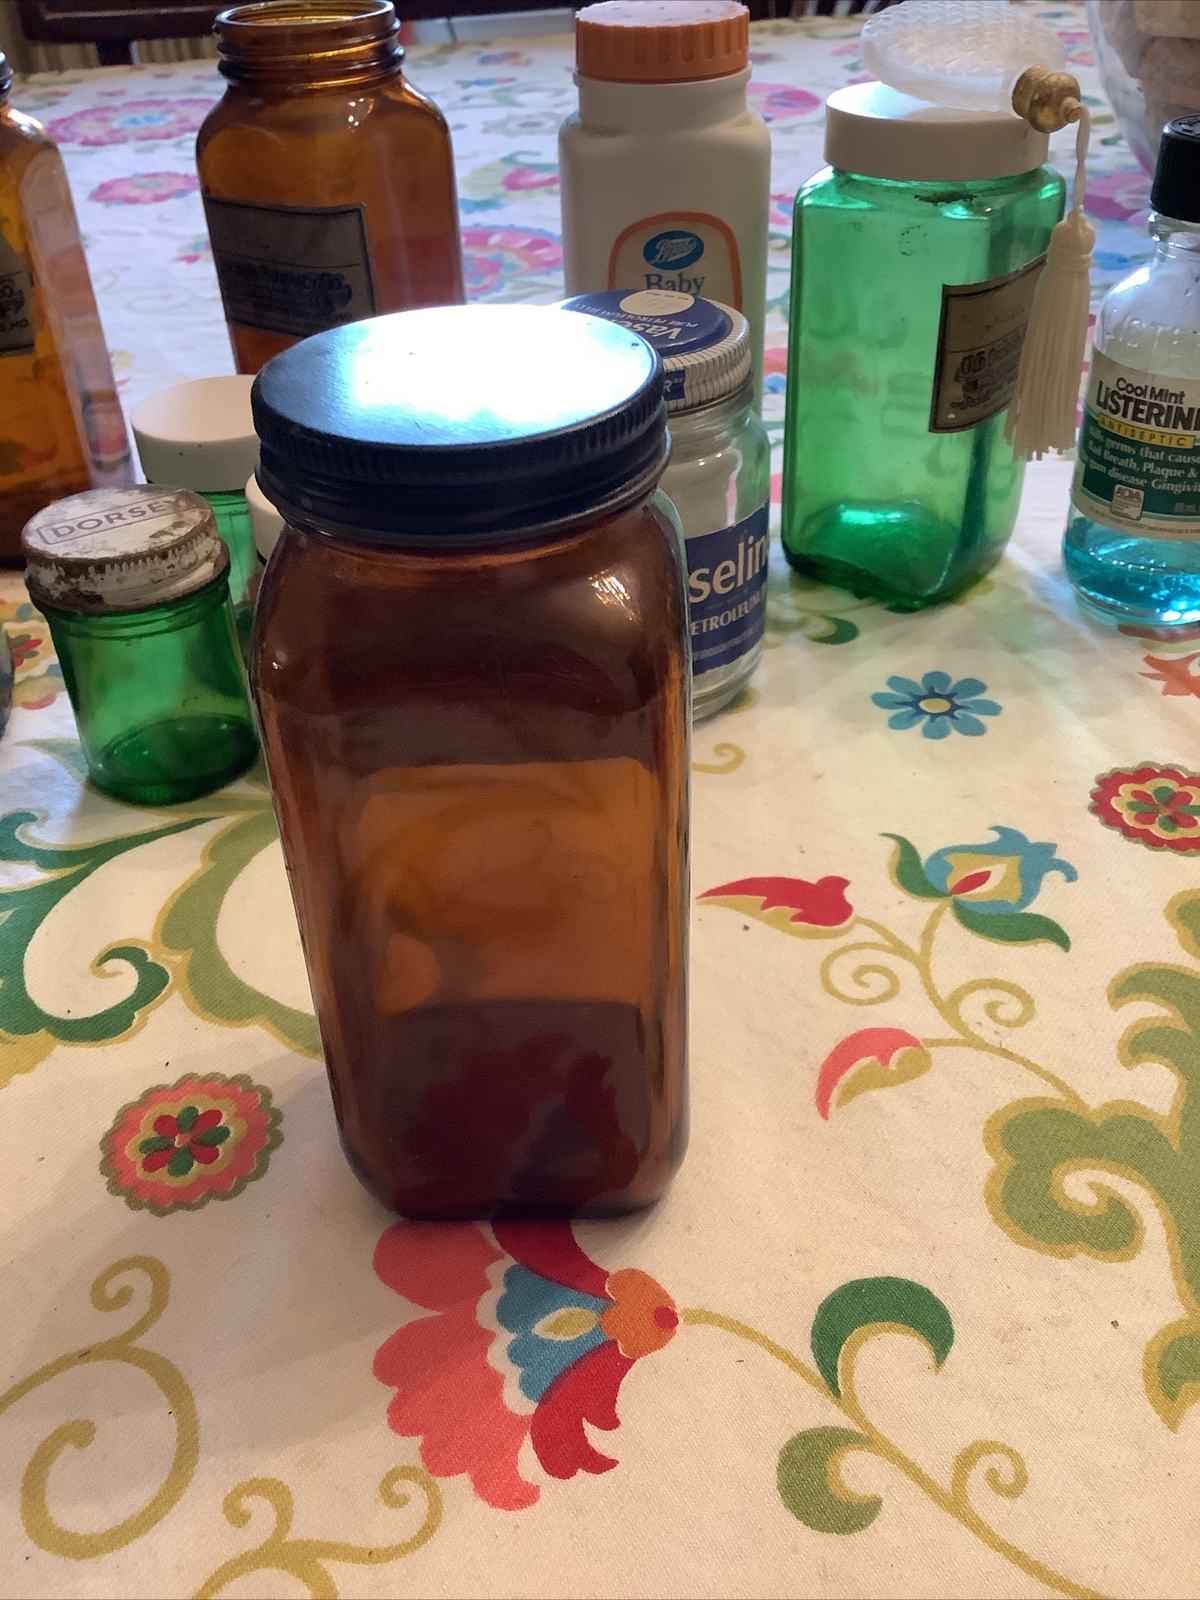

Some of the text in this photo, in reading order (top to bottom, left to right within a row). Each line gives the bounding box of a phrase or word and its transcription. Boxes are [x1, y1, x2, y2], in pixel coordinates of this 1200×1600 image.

[643, 272, 706, 297] Baby
[611, 320, 682, 340] Vase
[1116, 377, 1185, 404] Cool Mint
[1100, 416, 1187, 447] ANTISEPTIC
[1104, 438, 1137, 455] germs
[1139, 446, 1165, 461] that
[1108, 466, 1148, 487] disease
[1142, 461, 1186, 481] Plaque
[1187, 467, 1199, 478] &
[48, 497, 180, 538] DORSEY
